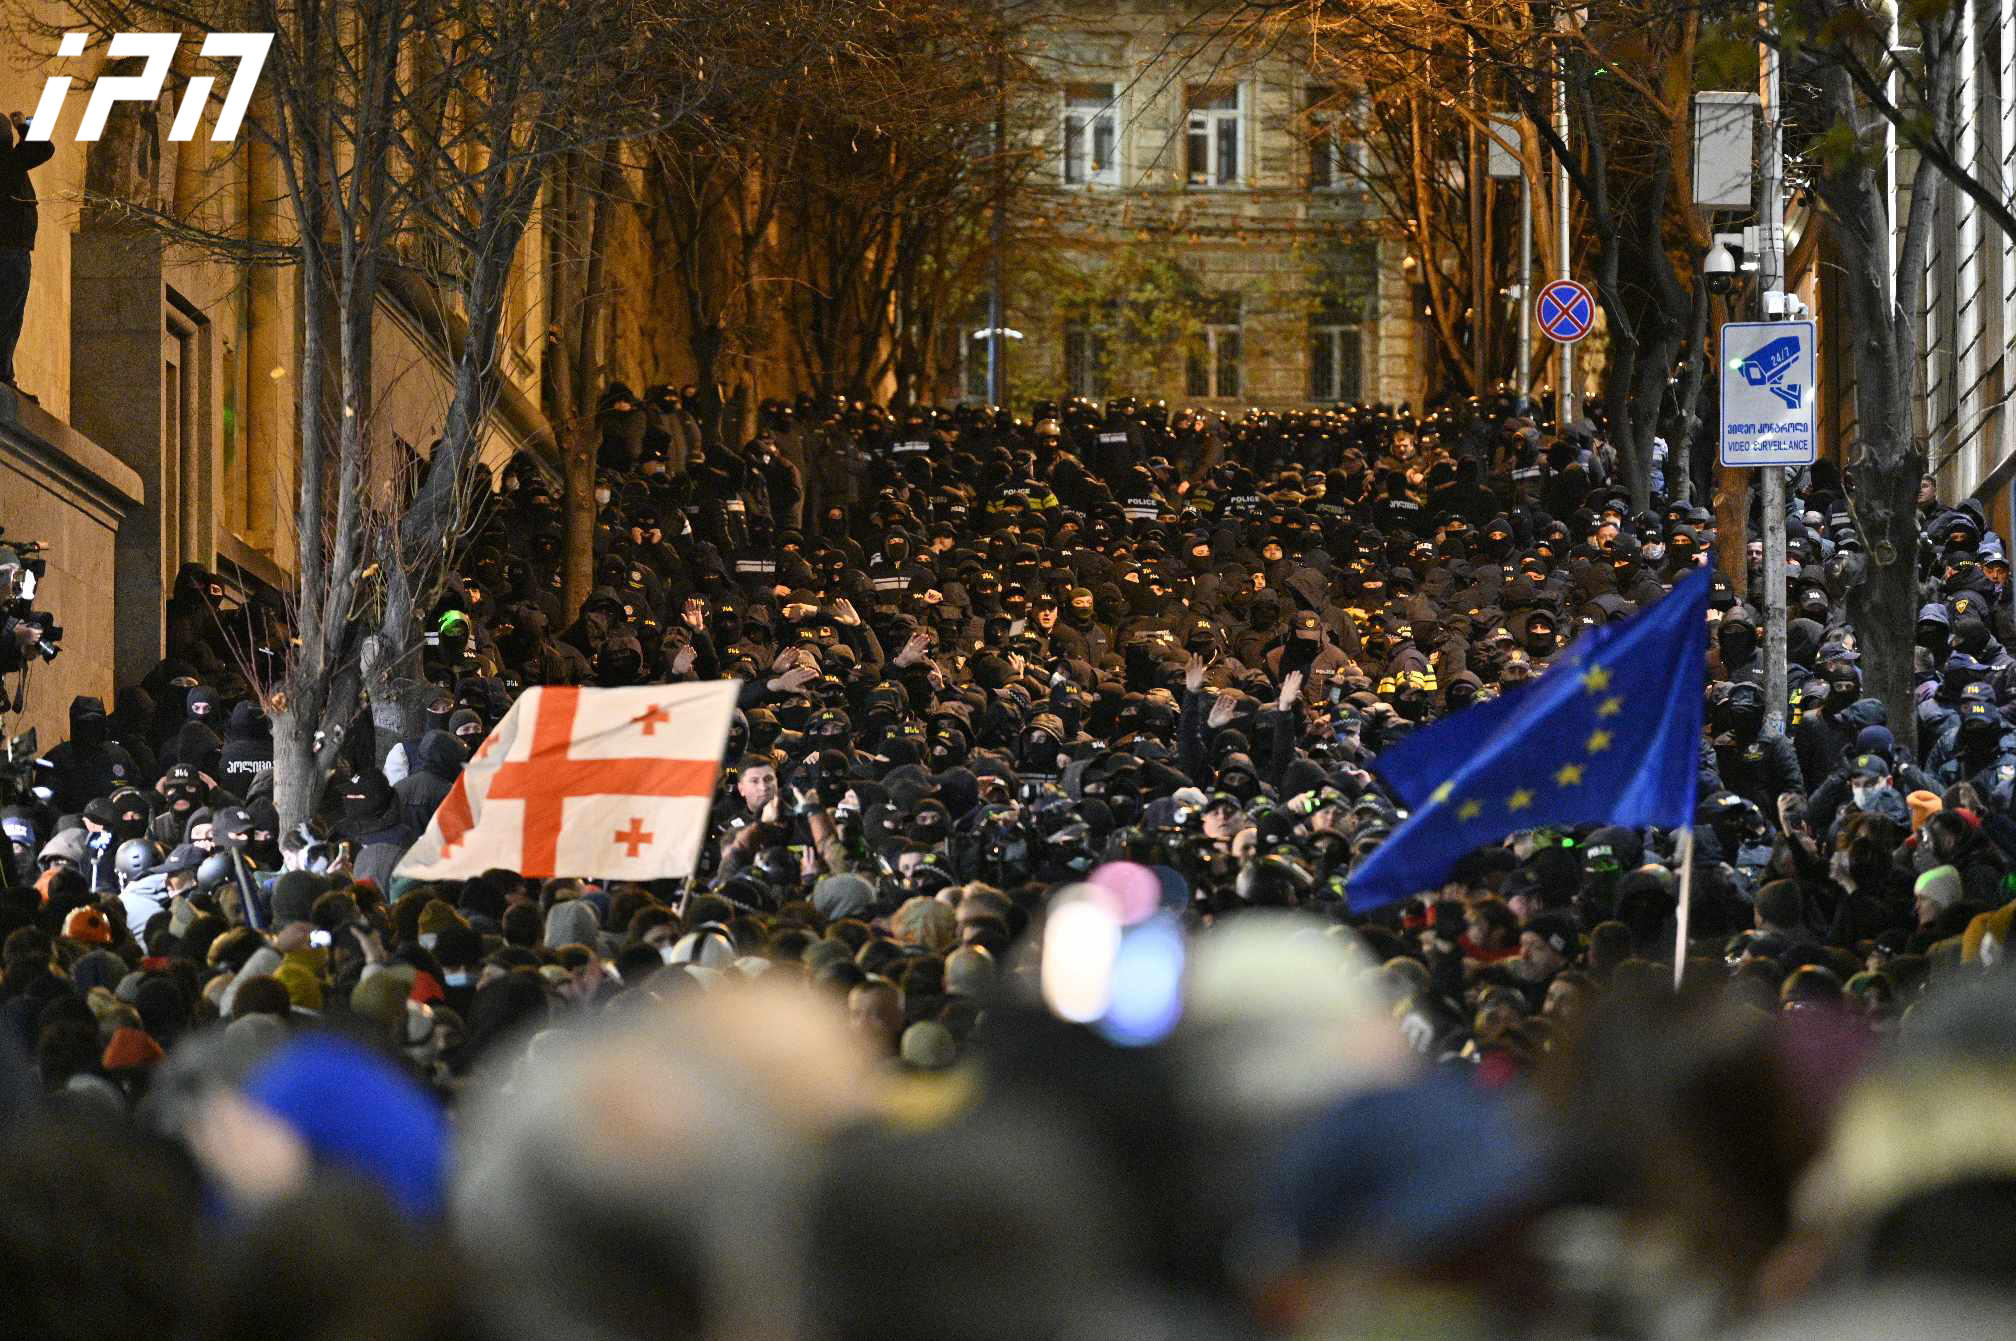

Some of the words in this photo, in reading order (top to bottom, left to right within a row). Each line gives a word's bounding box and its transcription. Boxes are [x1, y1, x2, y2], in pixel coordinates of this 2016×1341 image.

[1770, 346, 1790, 367] 24/7
[1728, 440, 1750, 452] VIDEO
[1127, 498, 1158, 506] POLICE
[226, 760, 273, 774] პოლიცი
